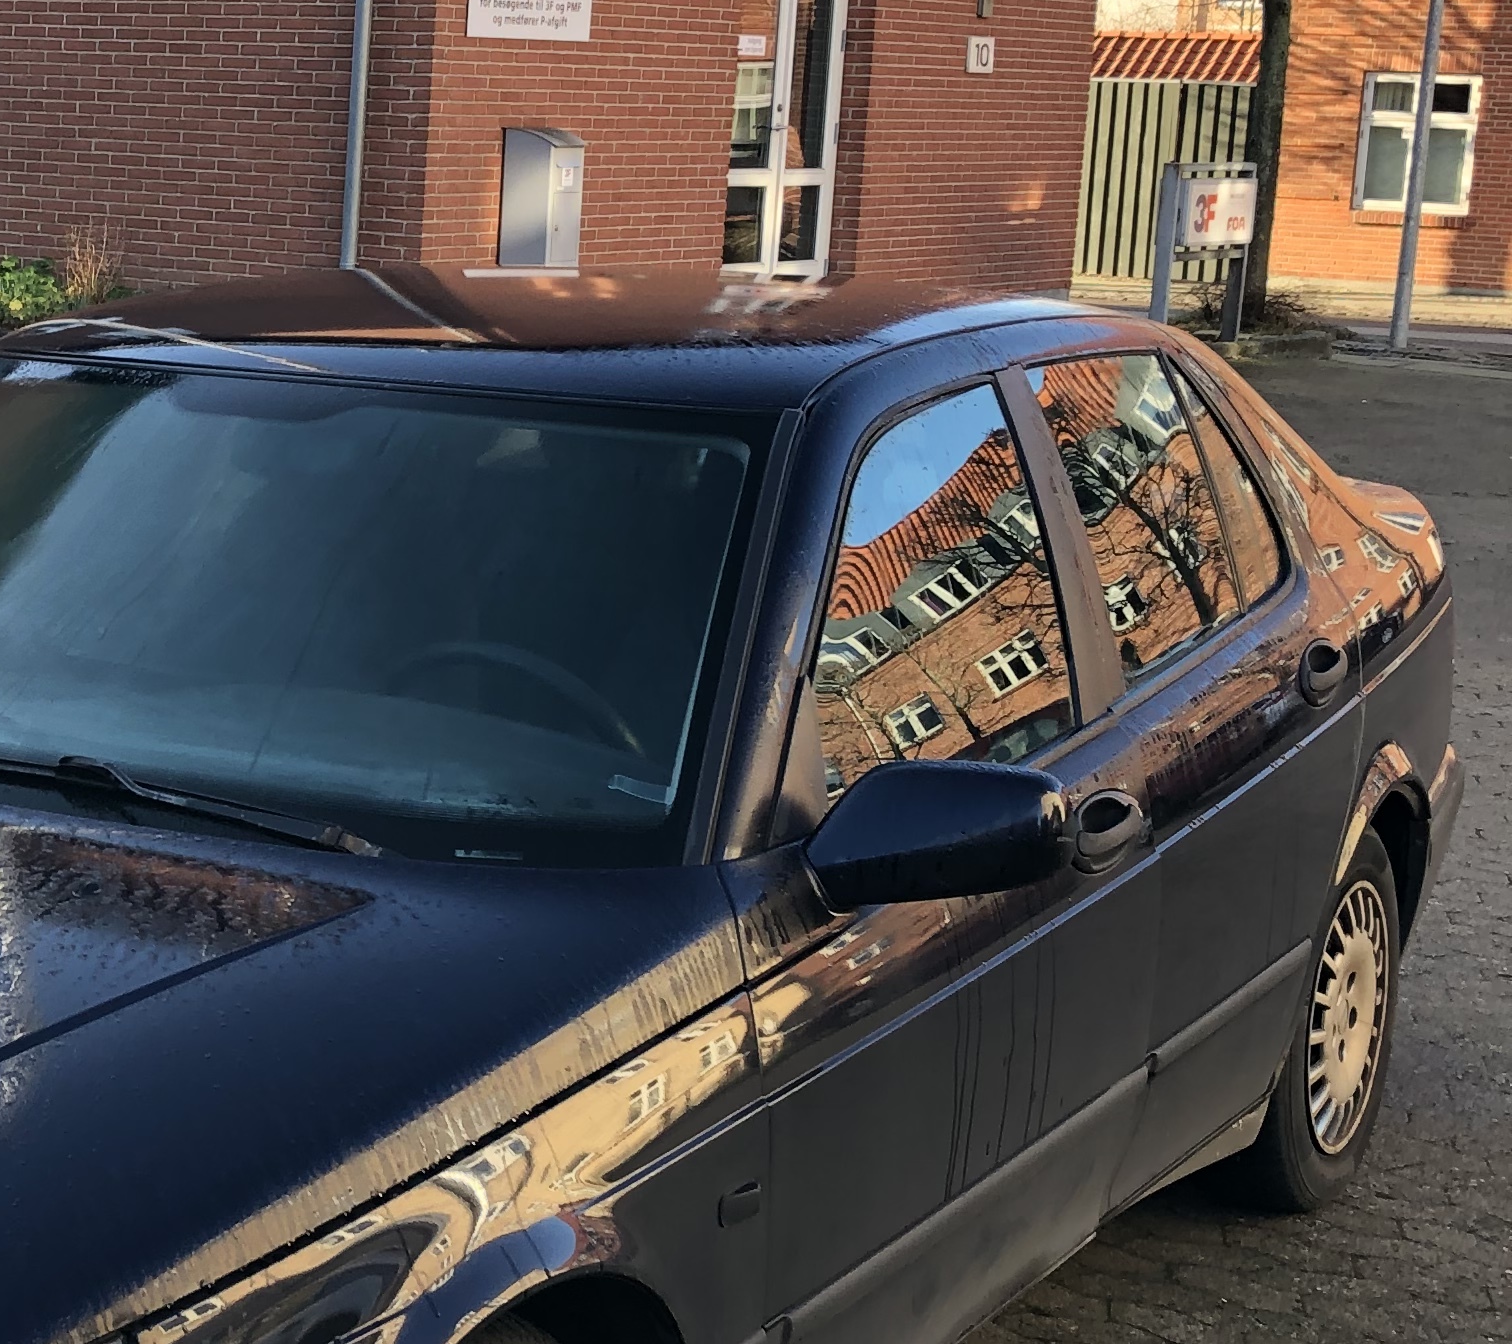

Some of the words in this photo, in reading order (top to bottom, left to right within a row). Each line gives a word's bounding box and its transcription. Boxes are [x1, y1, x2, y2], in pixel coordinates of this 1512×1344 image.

[492, 15, 502, 27] og
[504, 14, 539, 26] medfører
[975, 43, 990, 67] 10
[1194, 194, 1218, 233] 3F
[1227, 216, 1245, 231] FOA
